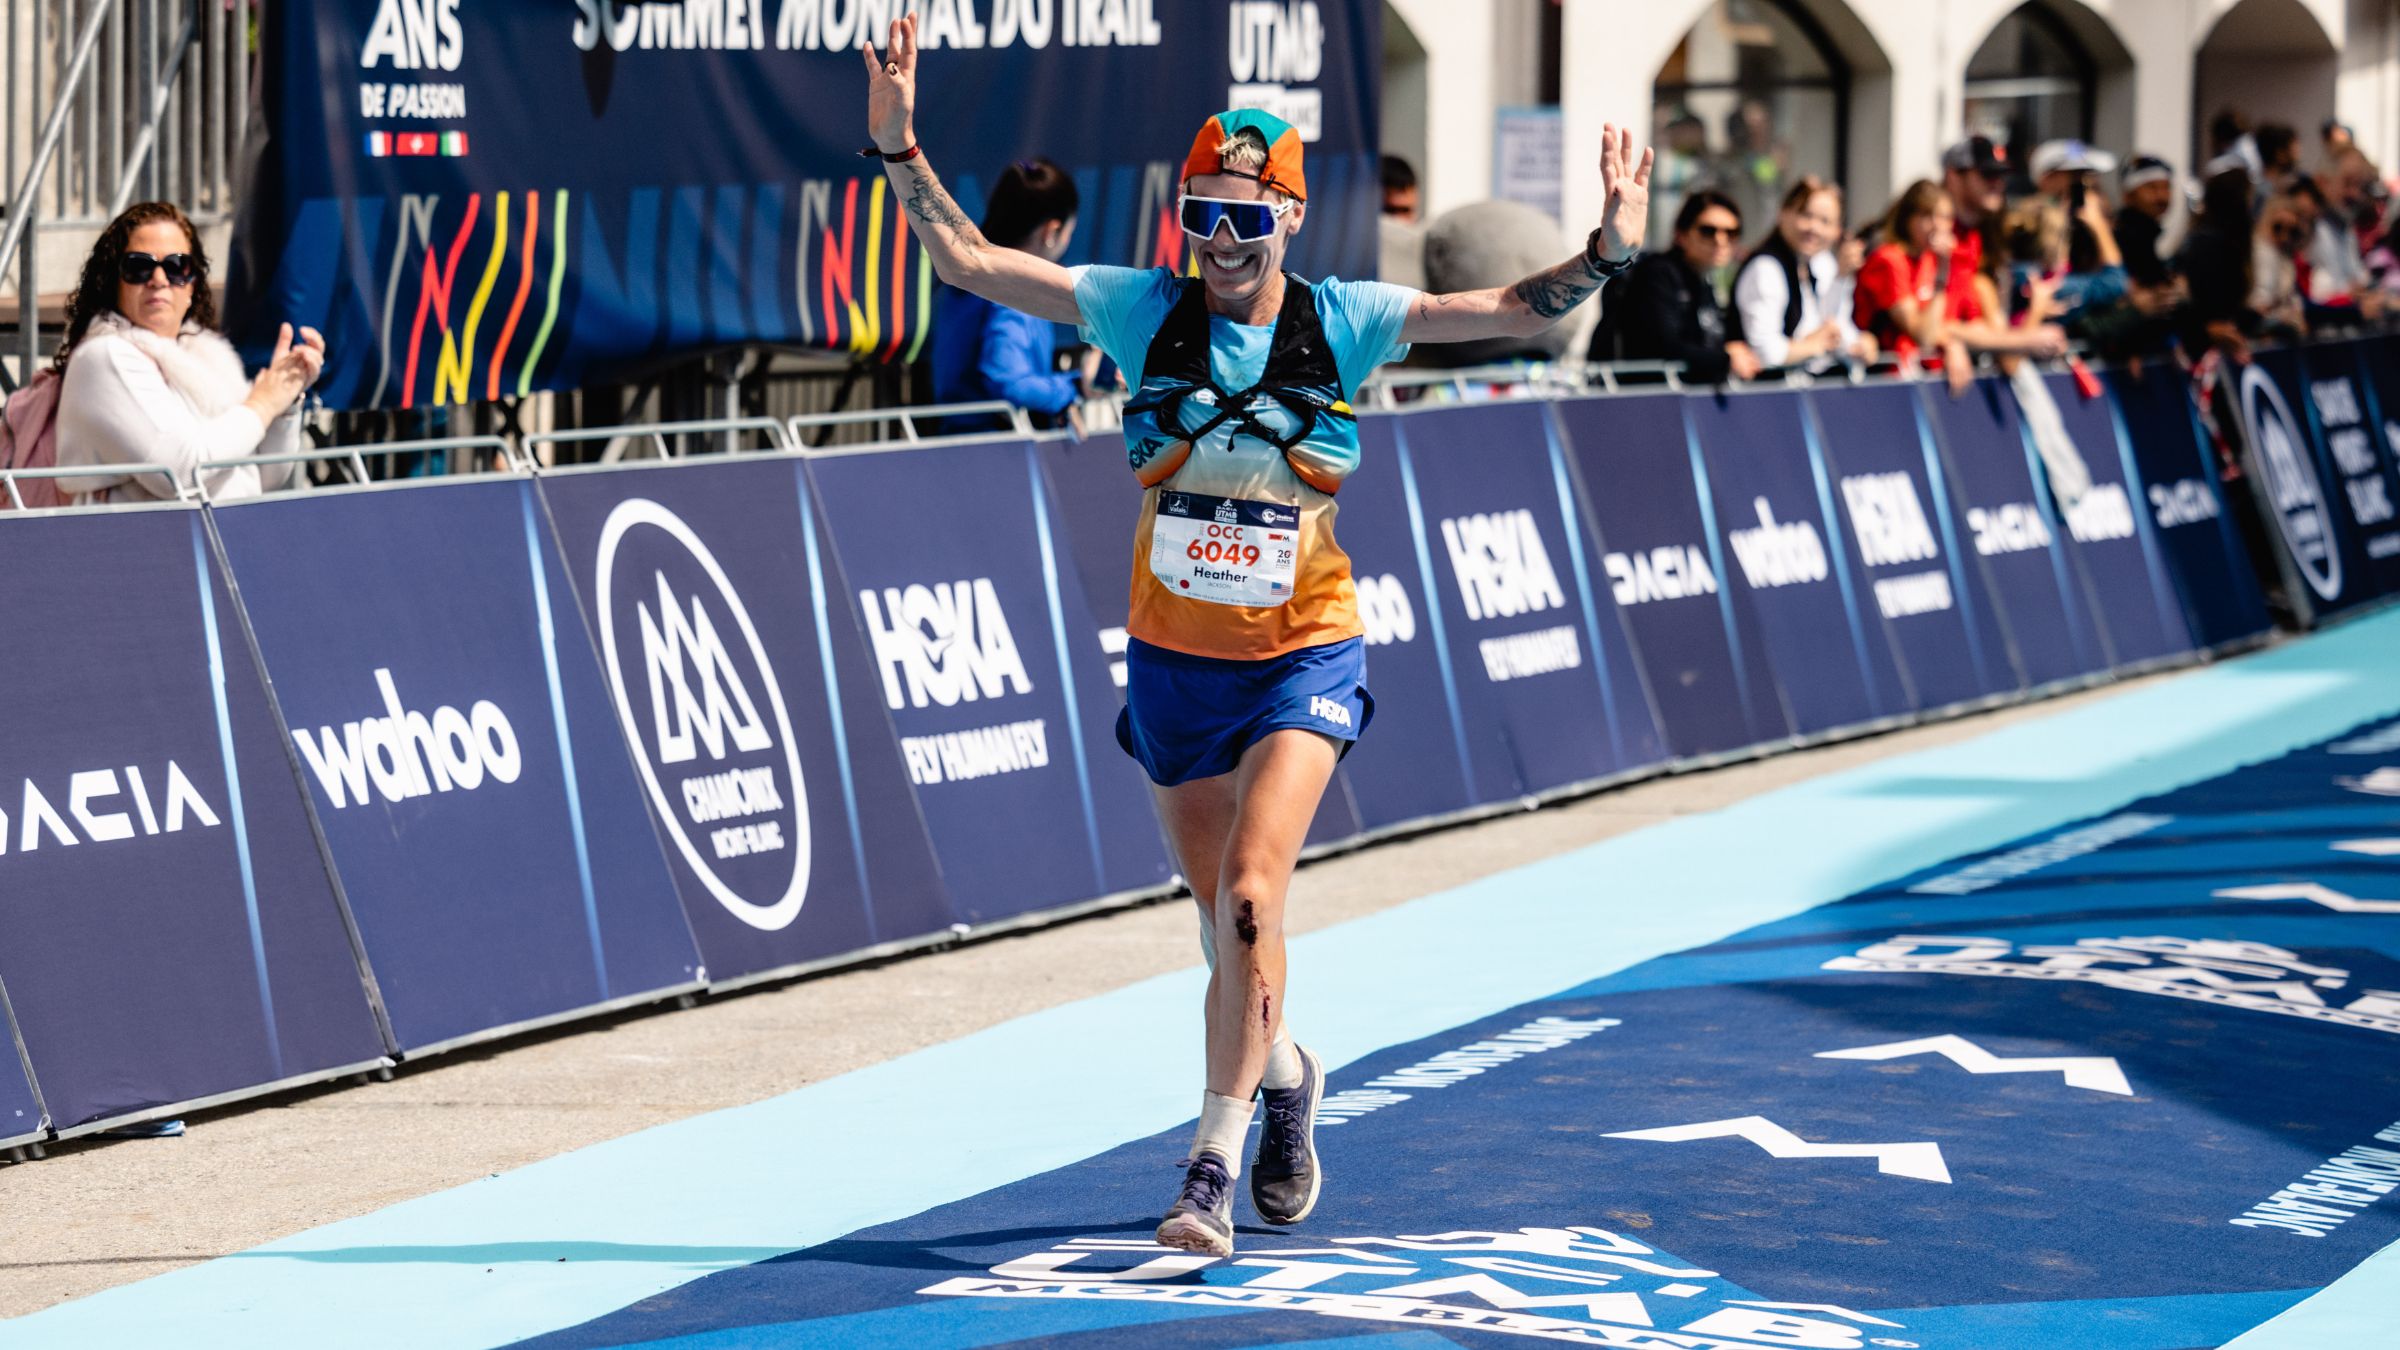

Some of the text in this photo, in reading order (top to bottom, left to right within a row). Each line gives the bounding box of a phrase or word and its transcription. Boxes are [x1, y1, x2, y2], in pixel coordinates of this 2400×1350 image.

[360, 0, 464, 71] ANS
[990, 0, 1052, 49] DU
[360, 83, 466, 119] DE PASSION
[1207, 523, 1244, 541] OCC
[1215, 509, 1238, 519] UTMB
[1186, 538, 1261, 567] 6049
[1194, 566, 1248, 583] Heather
[859, 577, 1034, 711] HOKA
[1310, 695, 1351, 728] HOKA
[291, 667, 522, 809] wahoo
[0, 759, 221, 856] ACIA
